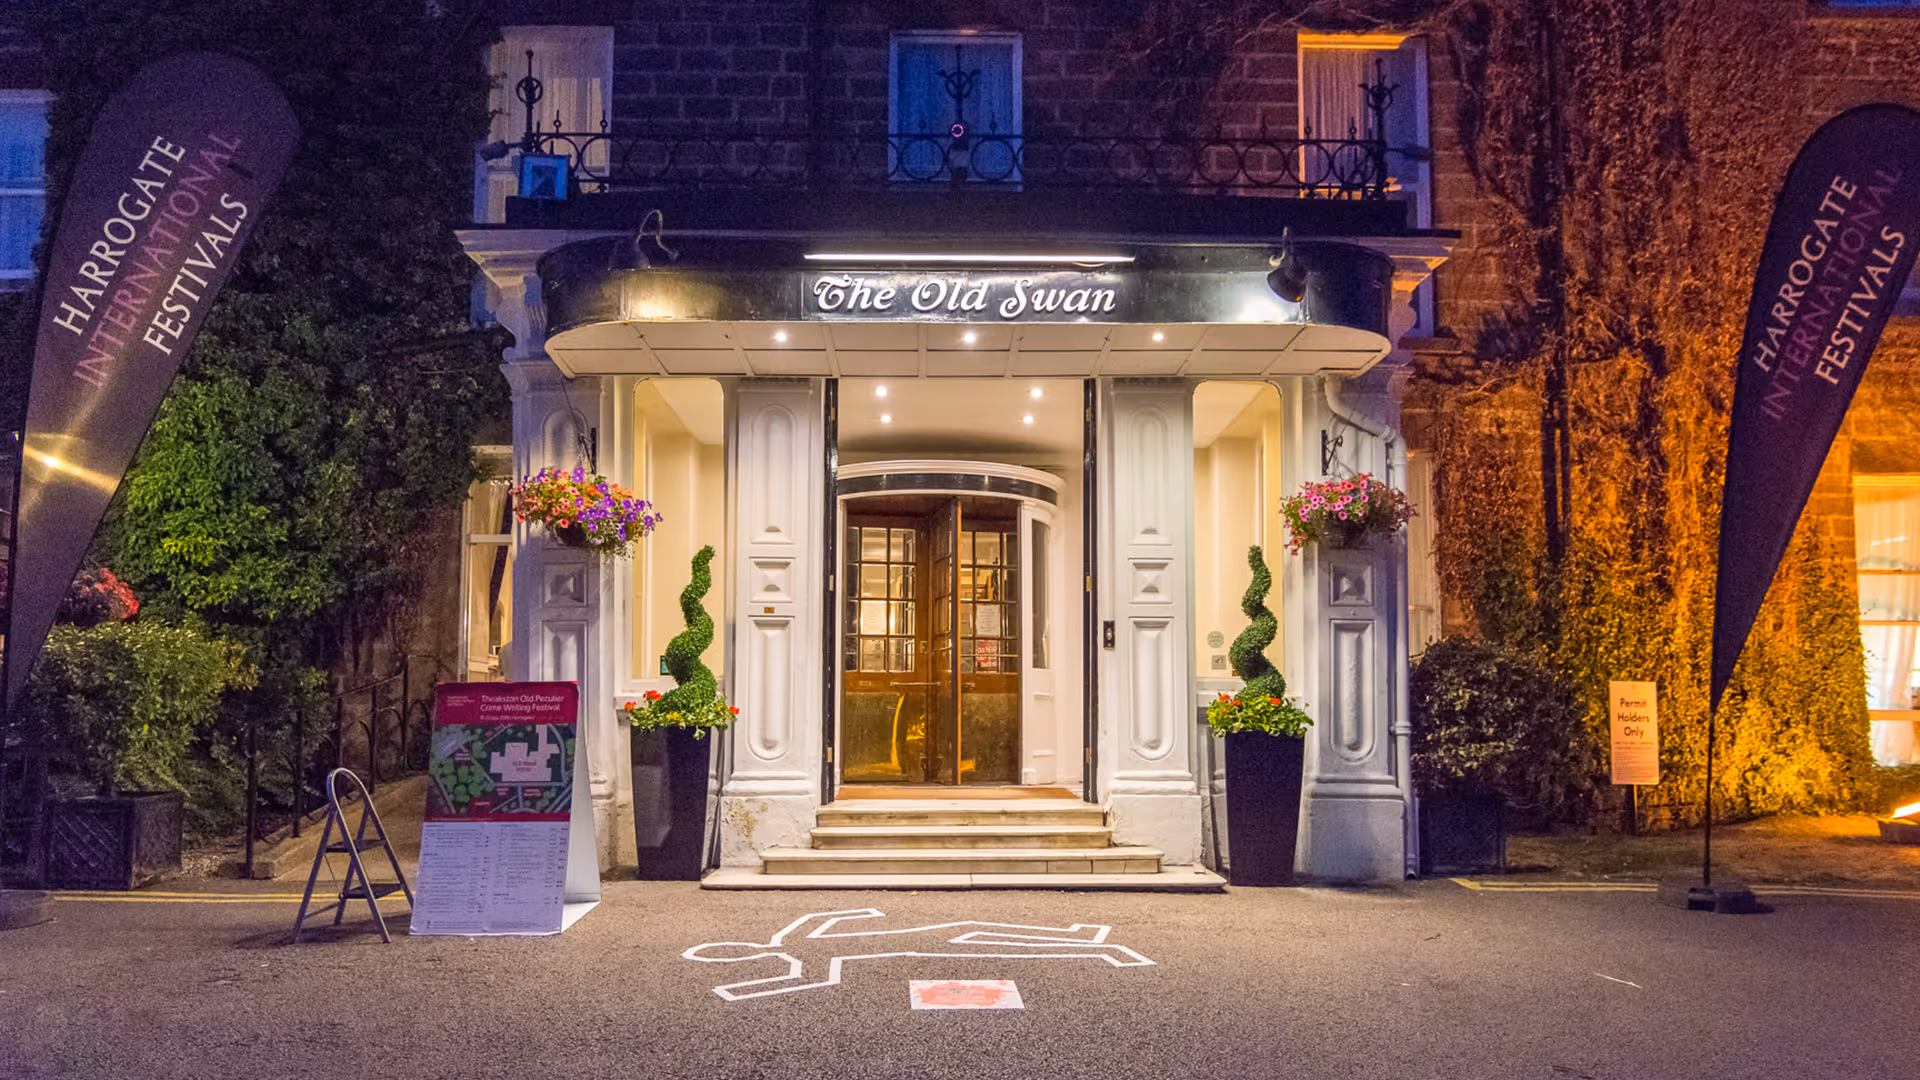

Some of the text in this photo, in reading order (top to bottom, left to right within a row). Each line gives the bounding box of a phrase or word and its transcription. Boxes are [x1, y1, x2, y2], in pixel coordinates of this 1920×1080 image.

[53, 135, 186, 335] HARROGATE
[73, 133, 241, 386] INTERNATIONAL
[143, 193, 248, 355] FESTIVALS
[1753, 176, 1858, 372] HARROGATE
[813, 274, 1116, 319] The Old Swan
[1761, 169, 1902, 419] INTERNATIONAL
[1814, 226, 1905, 385] FESTIVALS
[480, 703, 560, 714] Crime Writing Festival
[481, 694, 519, 703] Theakston
[519, 694, 534, 703] Old
[1617, 712, 1650, 723] Holders
[1619, 698, 1647, 708] Permit
[1623, 726, 1644, 739] Only
